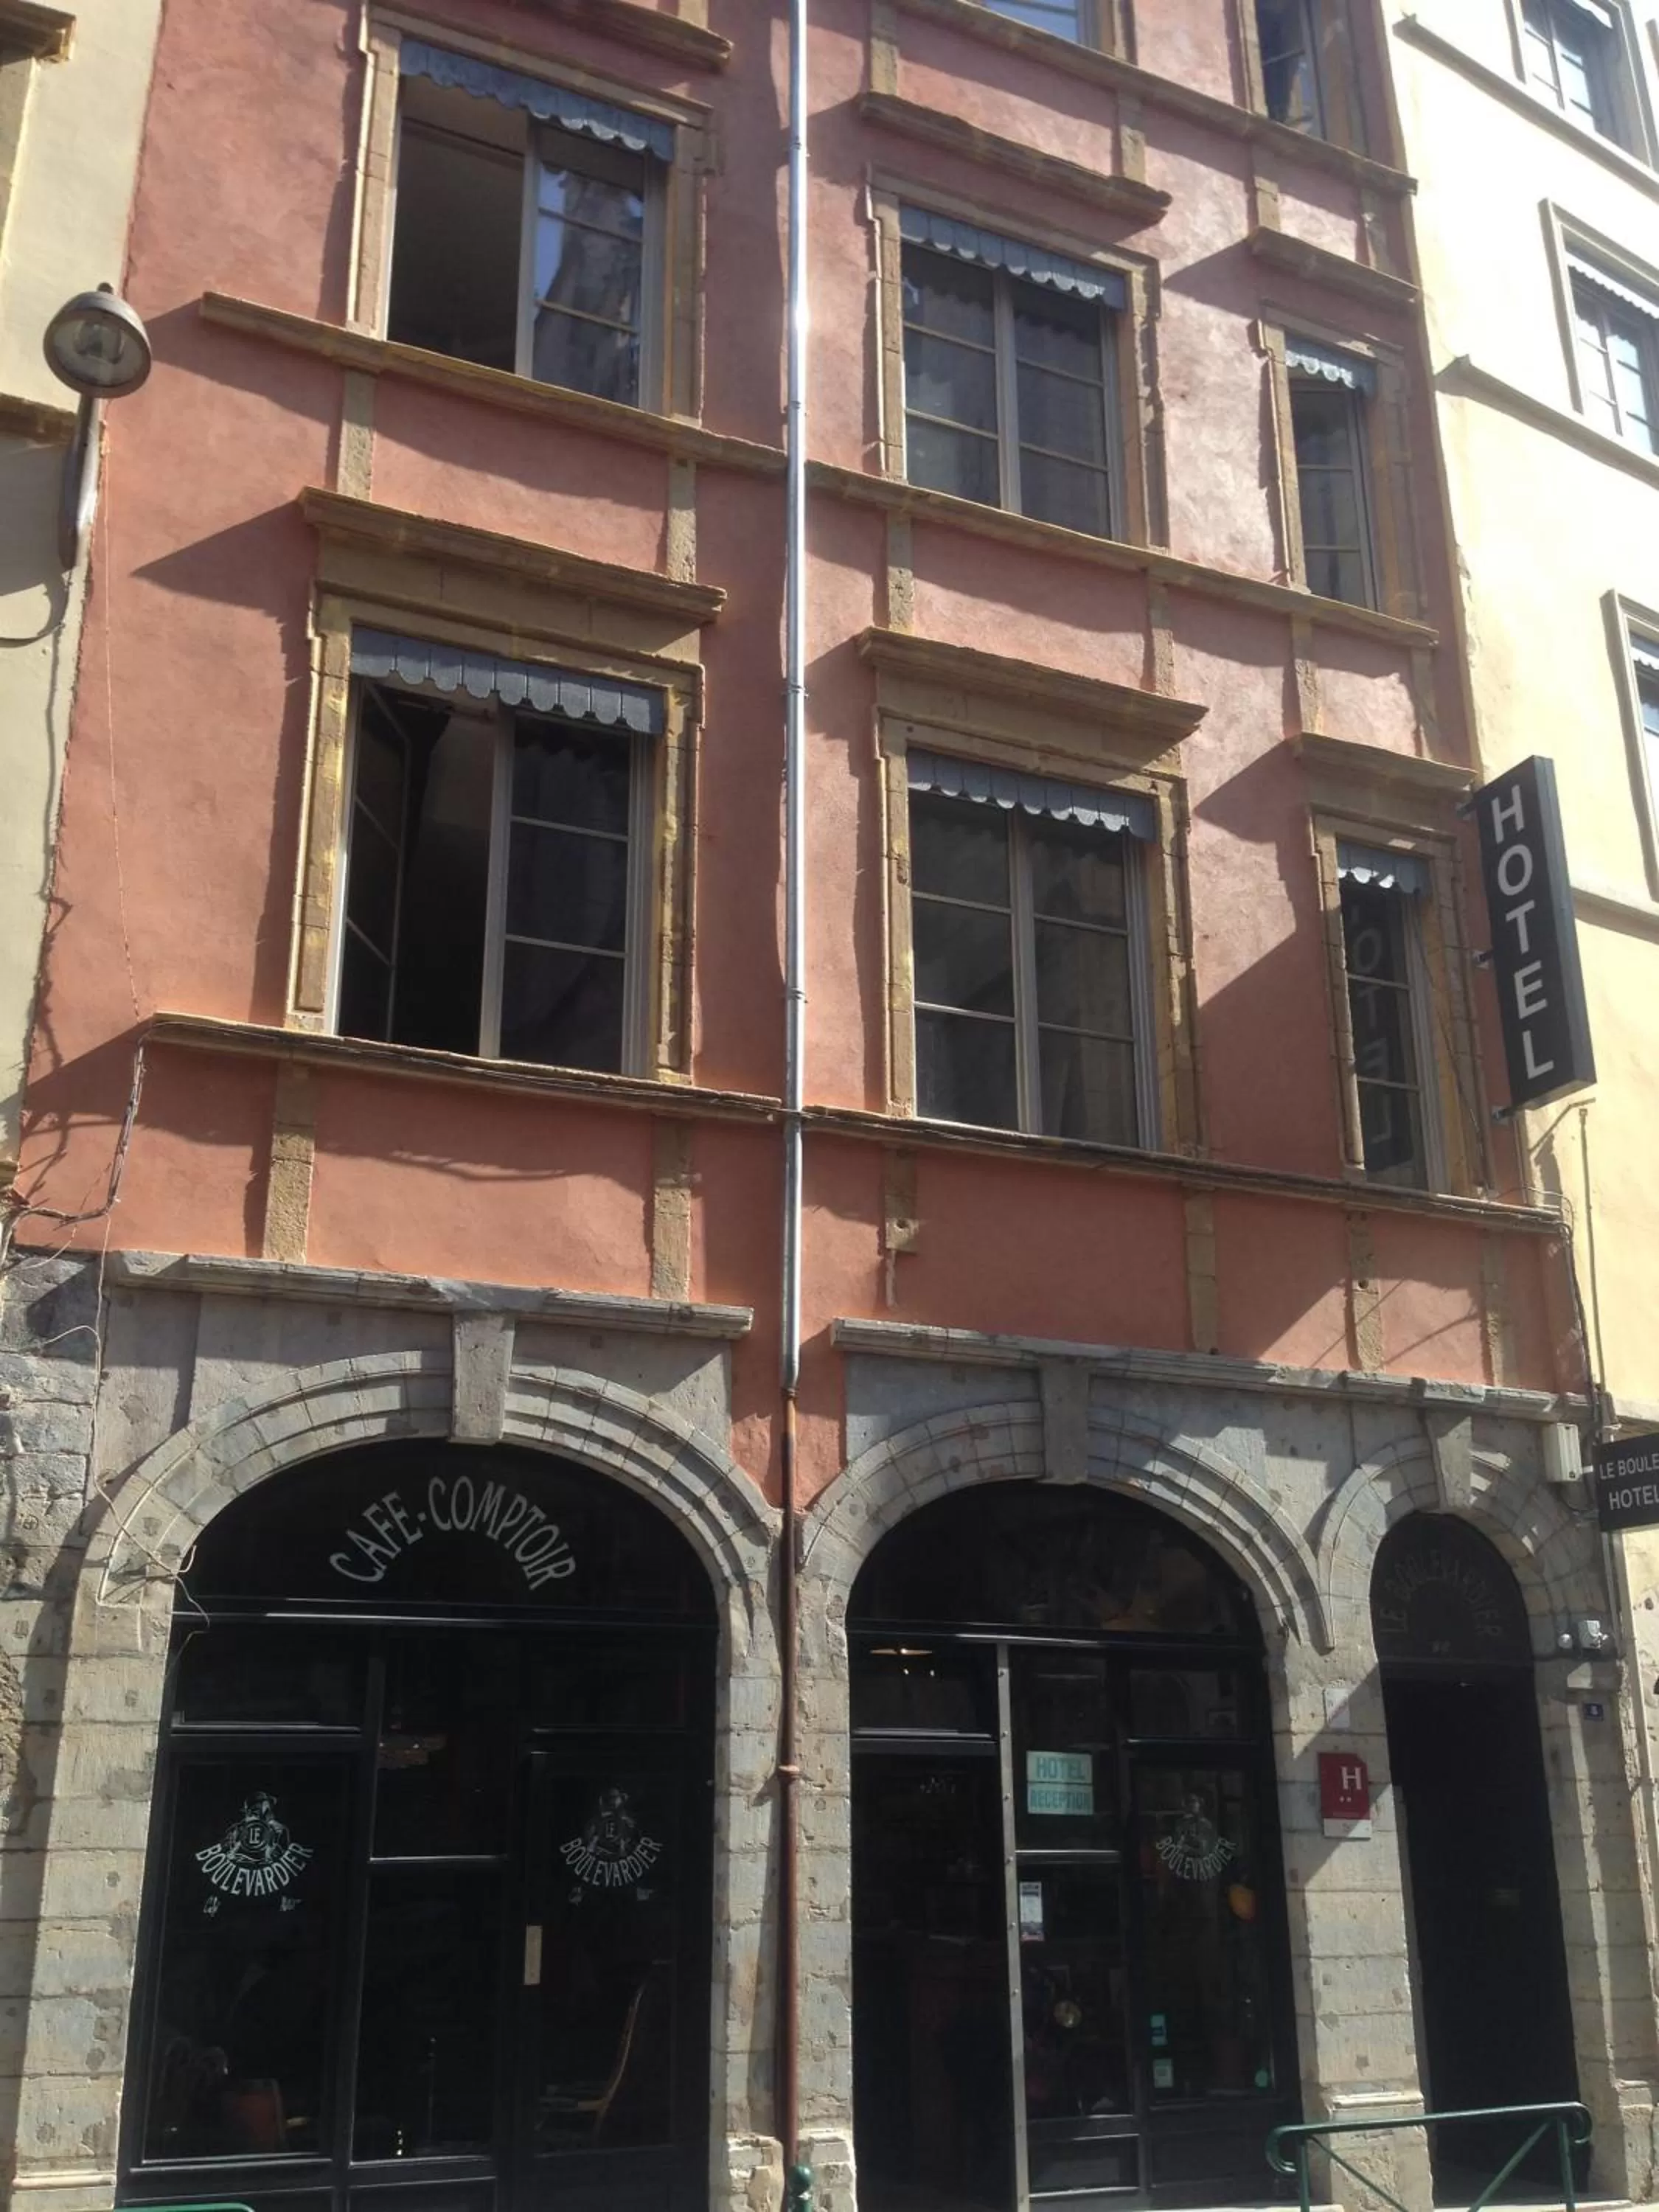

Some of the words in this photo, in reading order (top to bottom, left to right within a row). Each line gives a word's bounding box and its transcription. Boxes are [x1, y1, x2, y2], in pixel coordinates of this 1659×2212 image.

[1491, 784, 1554, 1080] HOTEL
[1599, 1461, 1616, 1481] LE
[1617, 1453, 1659, 1477] BOULE
[1608, 1484, 1659, 1511] HOTEL
[428, 1475, 577, 1590] COMPTOIR
[1036, 1756, 1086, 1780] HOTEL
[1340, 1765, 1363, 1791] H
[249, 1827, 262, 1844] LE
[195, 1842, 315, 1897] BOULEVARDIER
[559, 1836, 664, 1888] BOULEVARDIER
